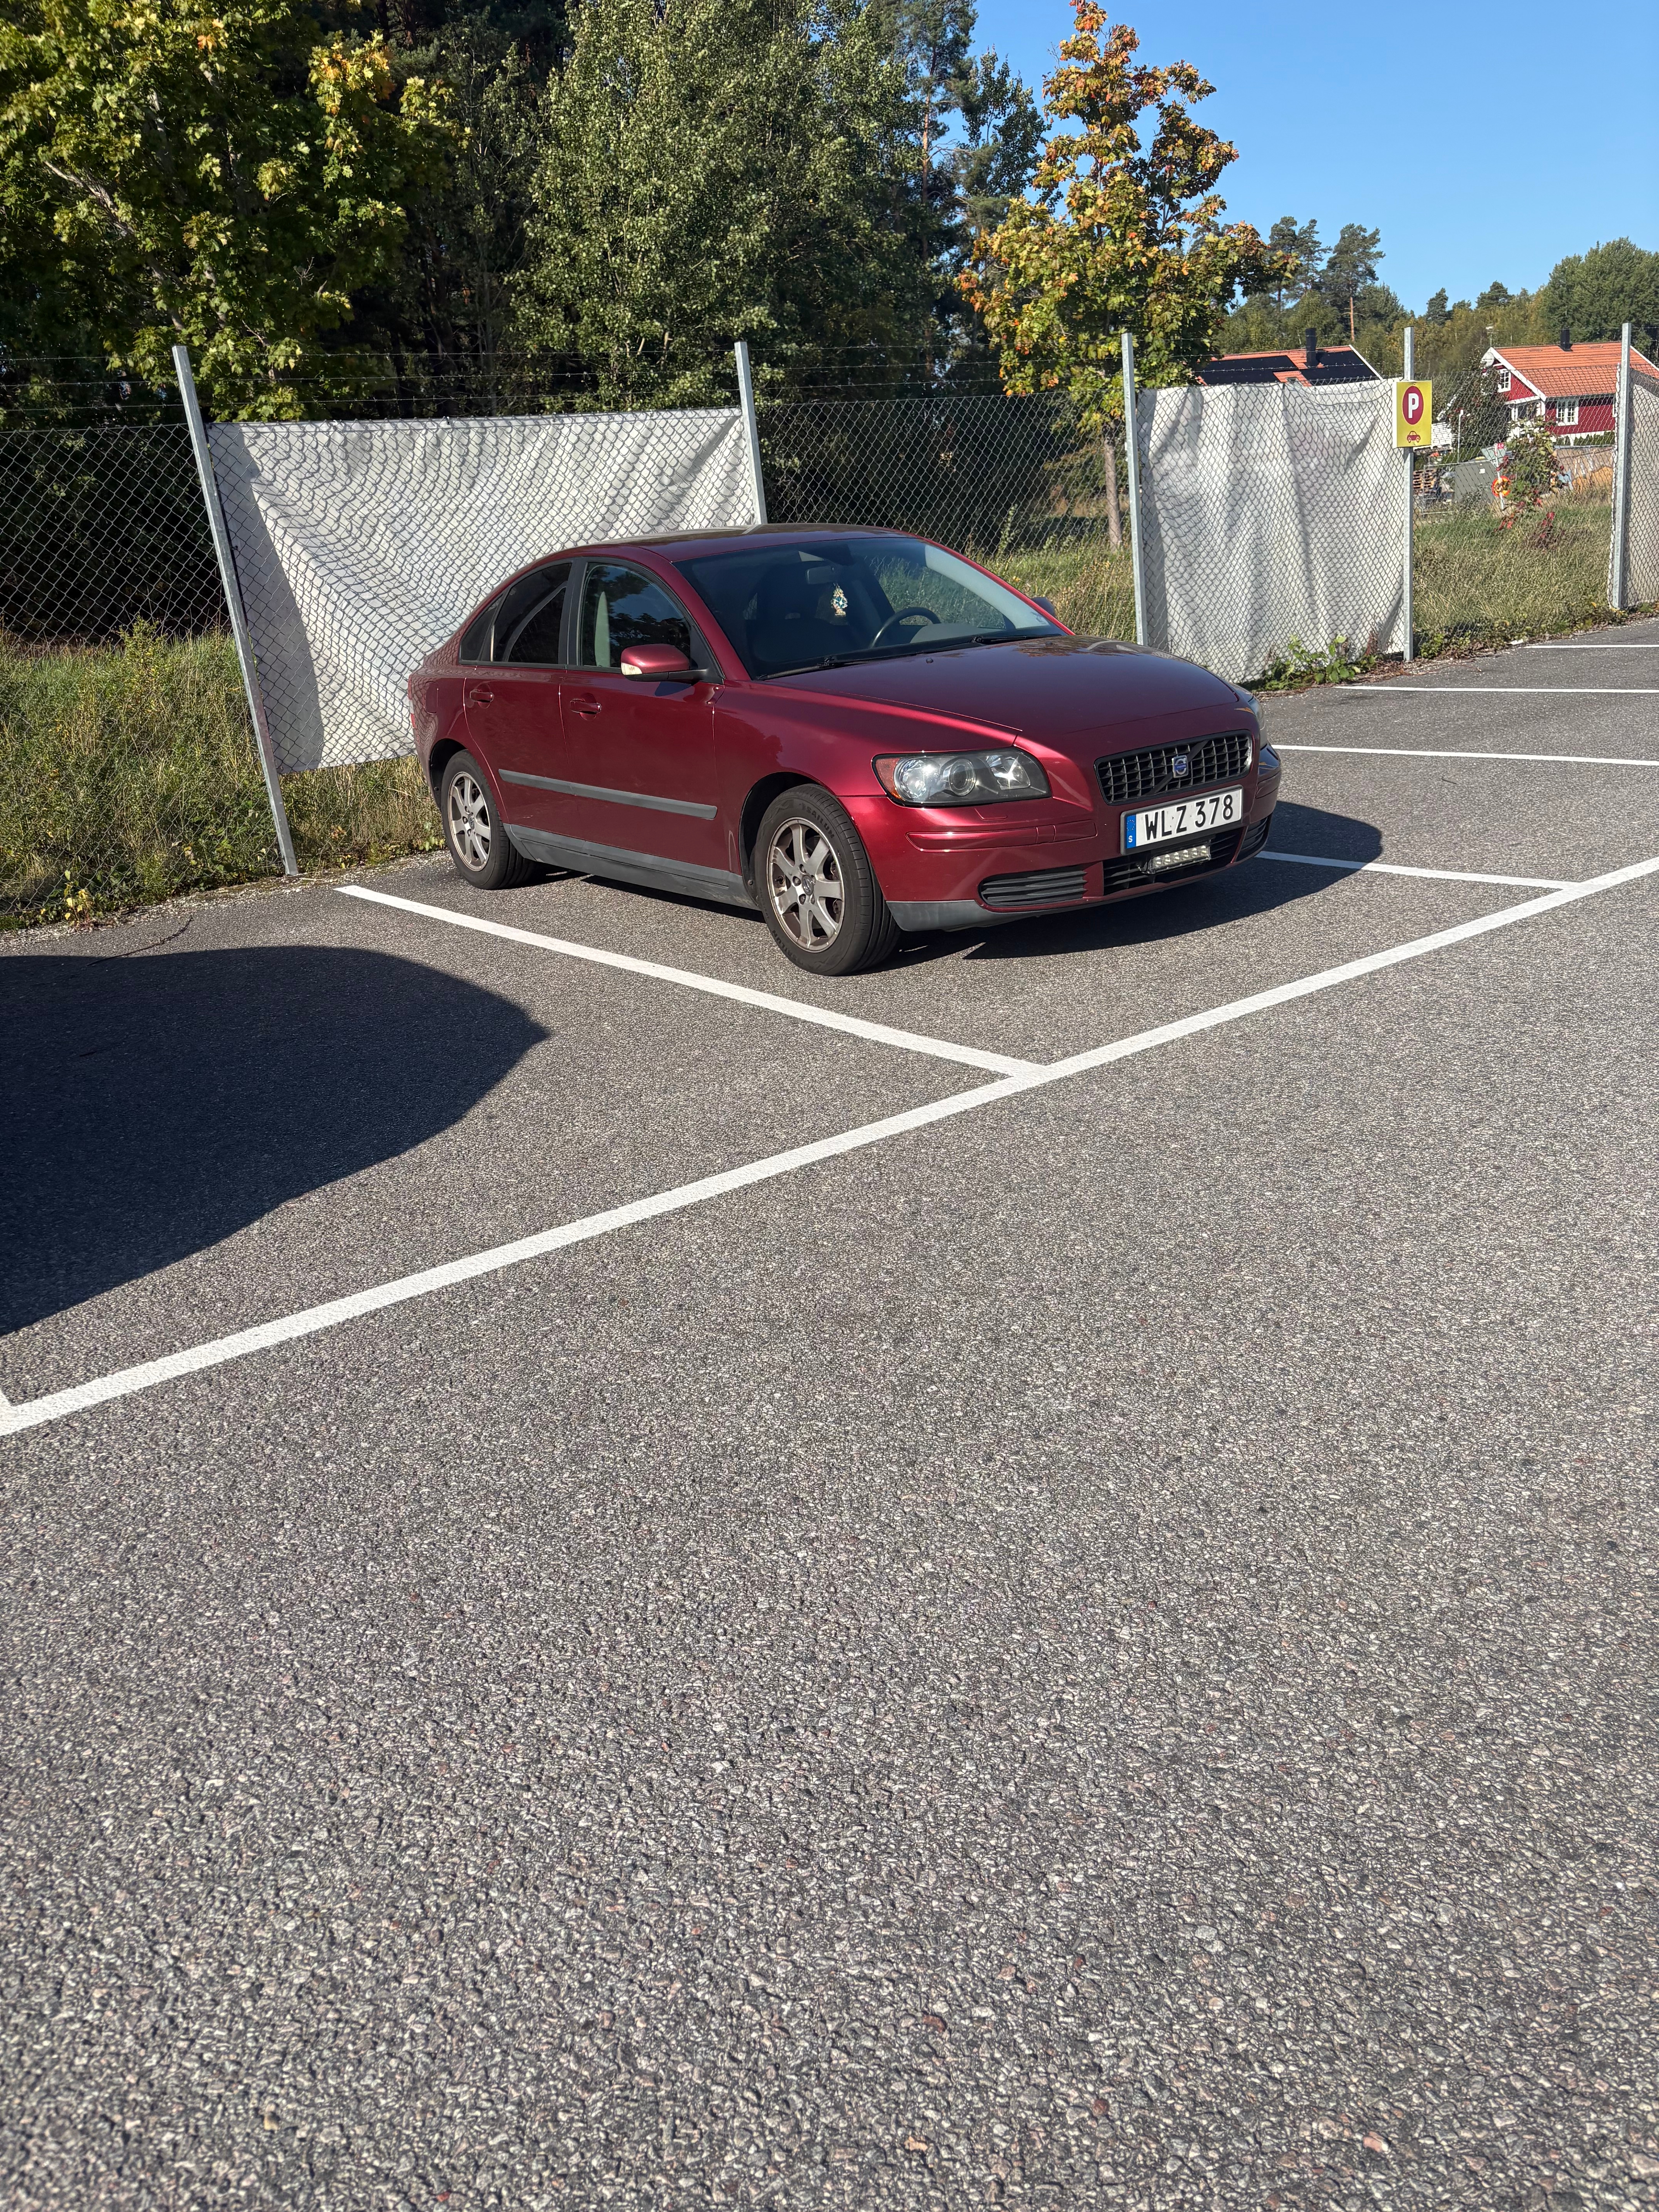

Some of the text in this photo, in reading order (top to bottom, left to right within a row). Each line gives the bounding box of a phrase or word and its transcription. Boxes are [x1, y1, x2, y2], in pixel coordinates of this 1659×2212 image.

[1408, 393, 1419, 419] P
[1145, 794, 1233, 840] WLZ 378
